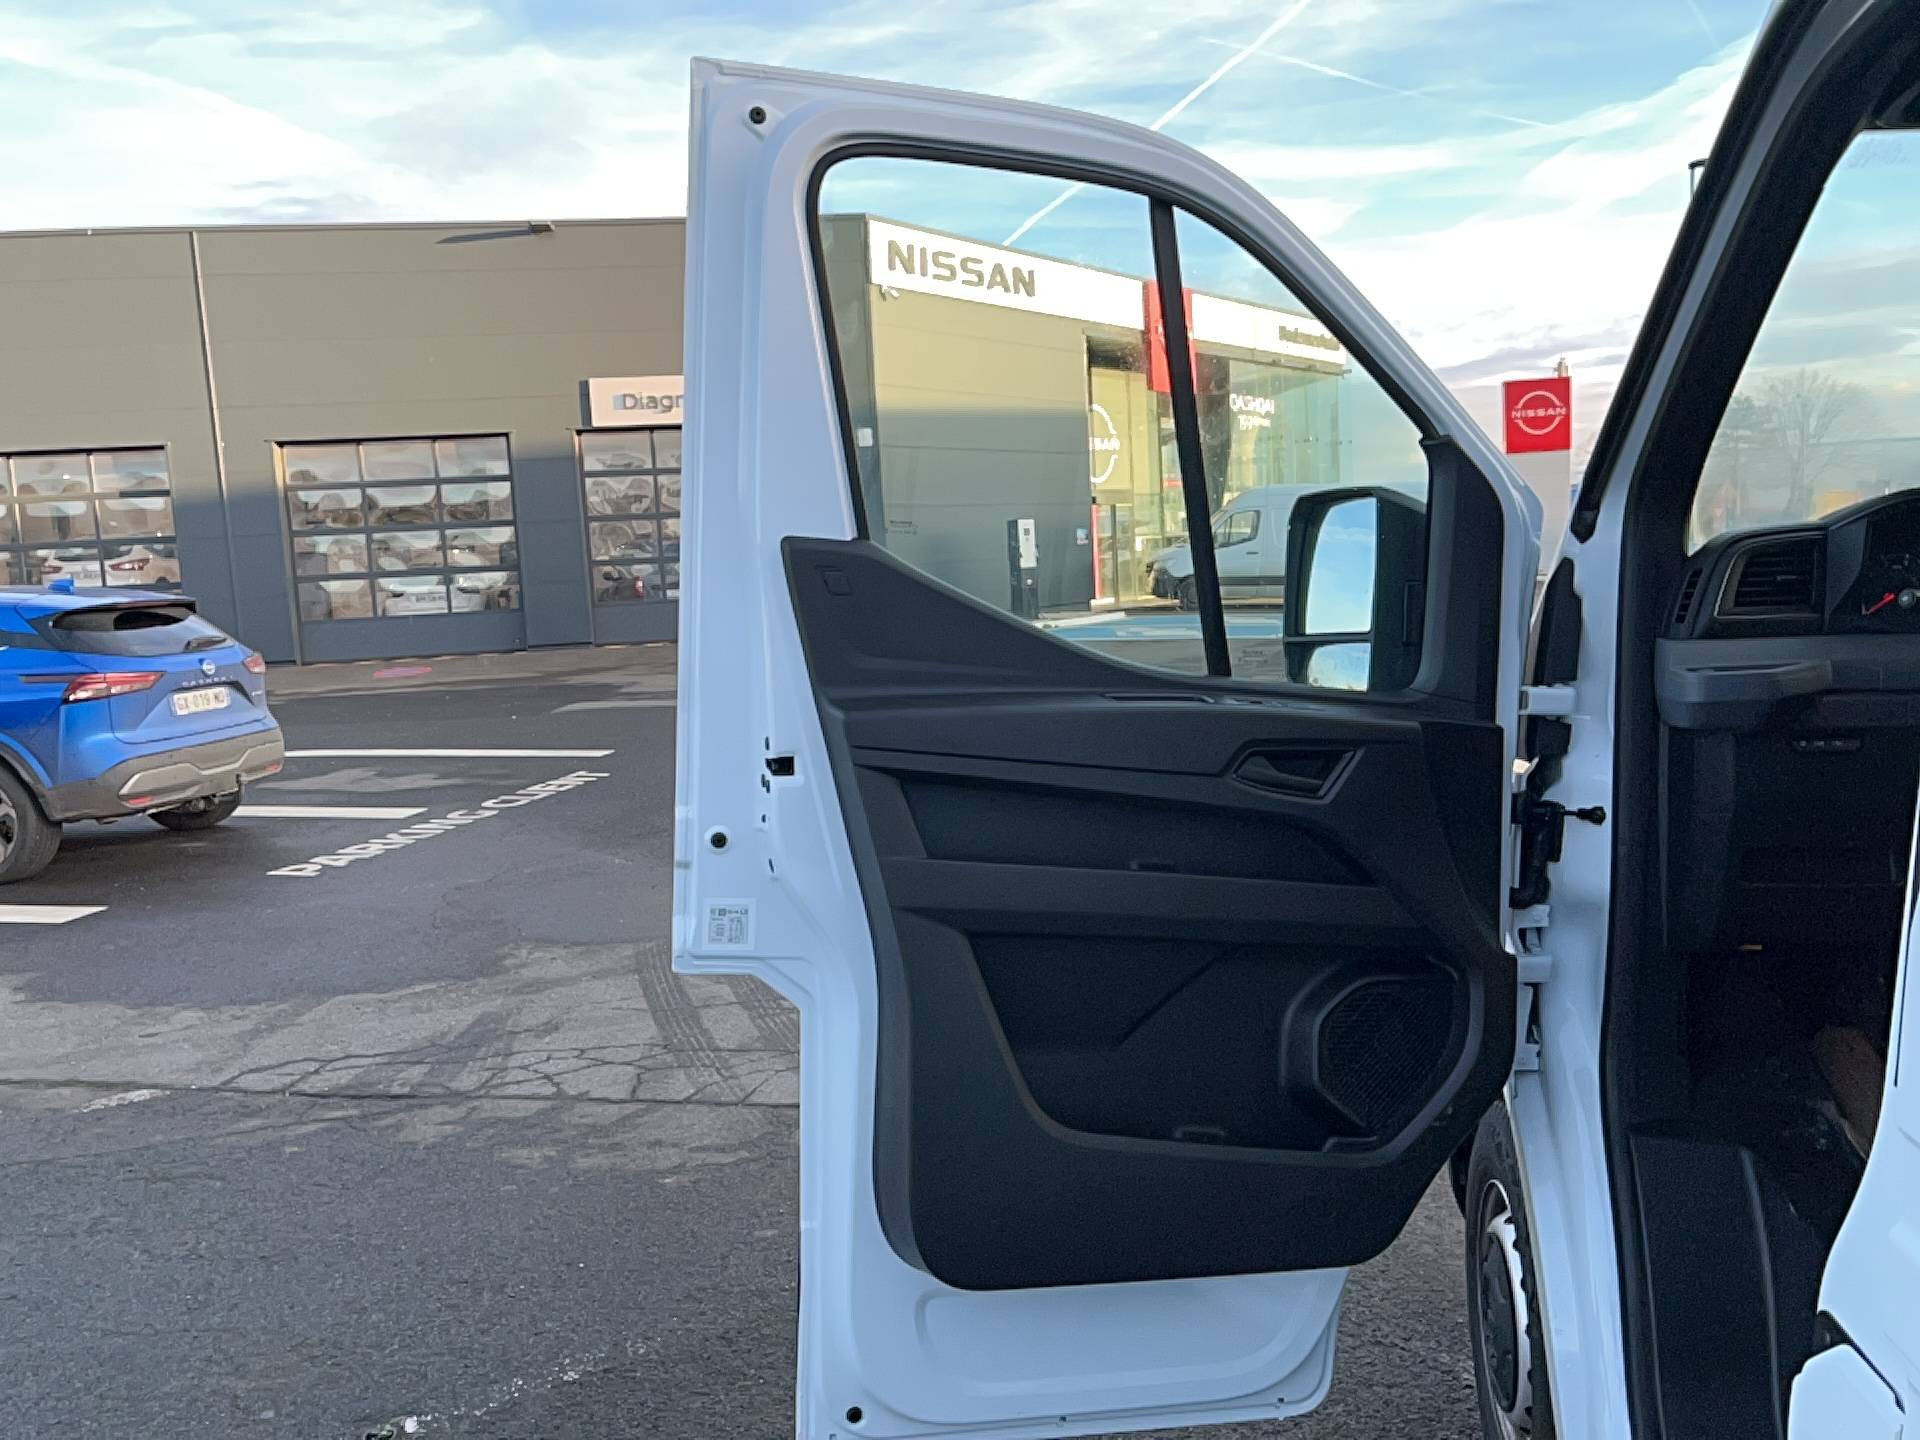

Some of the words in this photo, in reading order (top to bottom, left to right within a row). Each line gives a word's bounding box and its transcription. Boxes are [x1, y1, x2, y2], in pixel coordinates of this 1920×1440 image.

[888, 239, 1036, 297] NISSAN
[1511, 406, 1567, 419] NISSAN
[265, 808, 499, 877] PARKING
[481, 770, 611, 807] CLIENT
